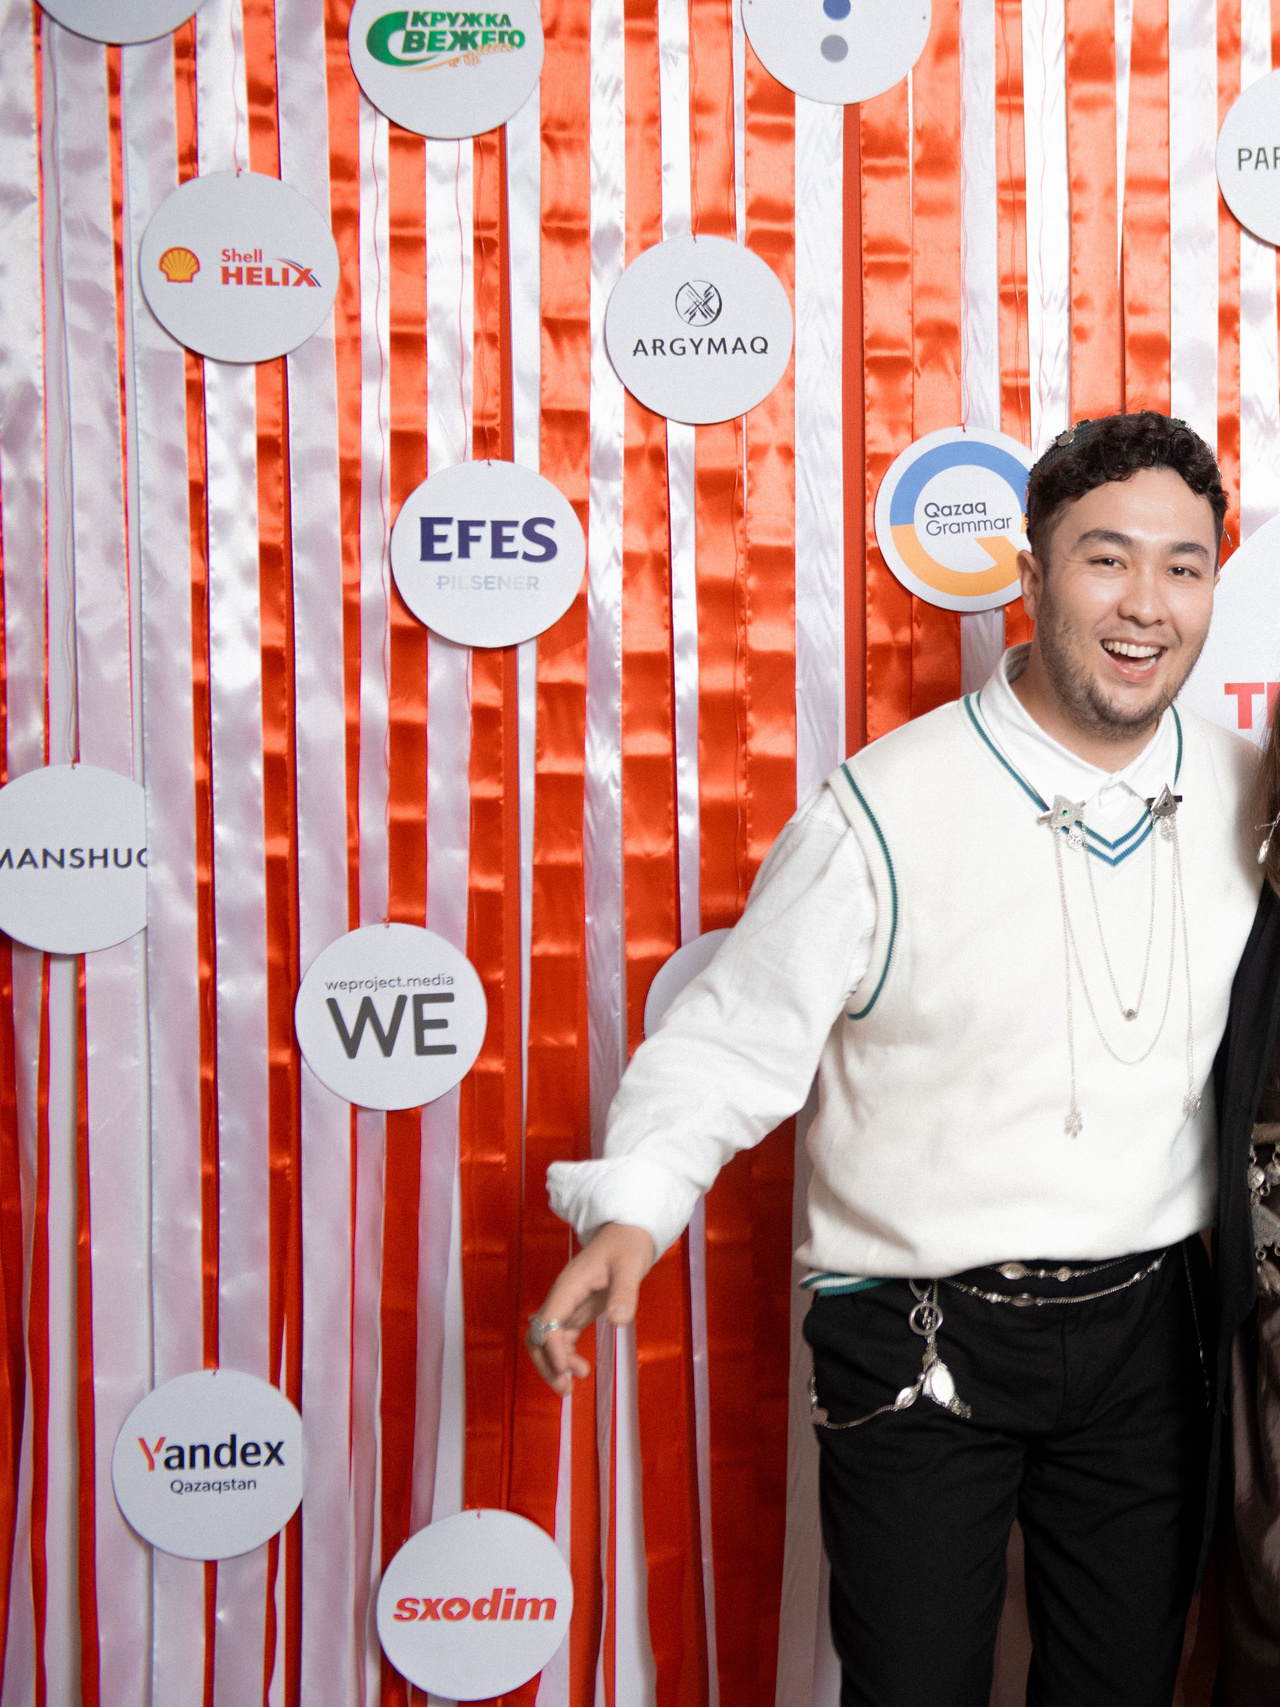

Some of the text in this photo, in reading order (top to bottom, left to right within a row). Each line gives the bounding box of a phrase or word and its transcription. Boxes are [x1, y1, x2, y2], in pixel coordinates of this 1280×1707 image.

[410, 10, 513, 28] КРУЖКА
[221, 248, 263, 263] Shell
[221, 264, 320, 287] HELIX
[632, 336, 770, 357] ARGYMAQ
[923, 501, 987, 520] Qazaq
[925, 516, 1013, 537] Grammar
[419, 516, 558, 563] EFES
[436, 574, 539, 591] PILSENER
[325, 974, 454, 993] weproject.media
[326, 993, 457, 1059] WE
[137, 1434, 285, 1472] Yandex
[170, 1477, 257, 1494] Qazaqstan
[393, 1588, 557, 1622] sxodim
